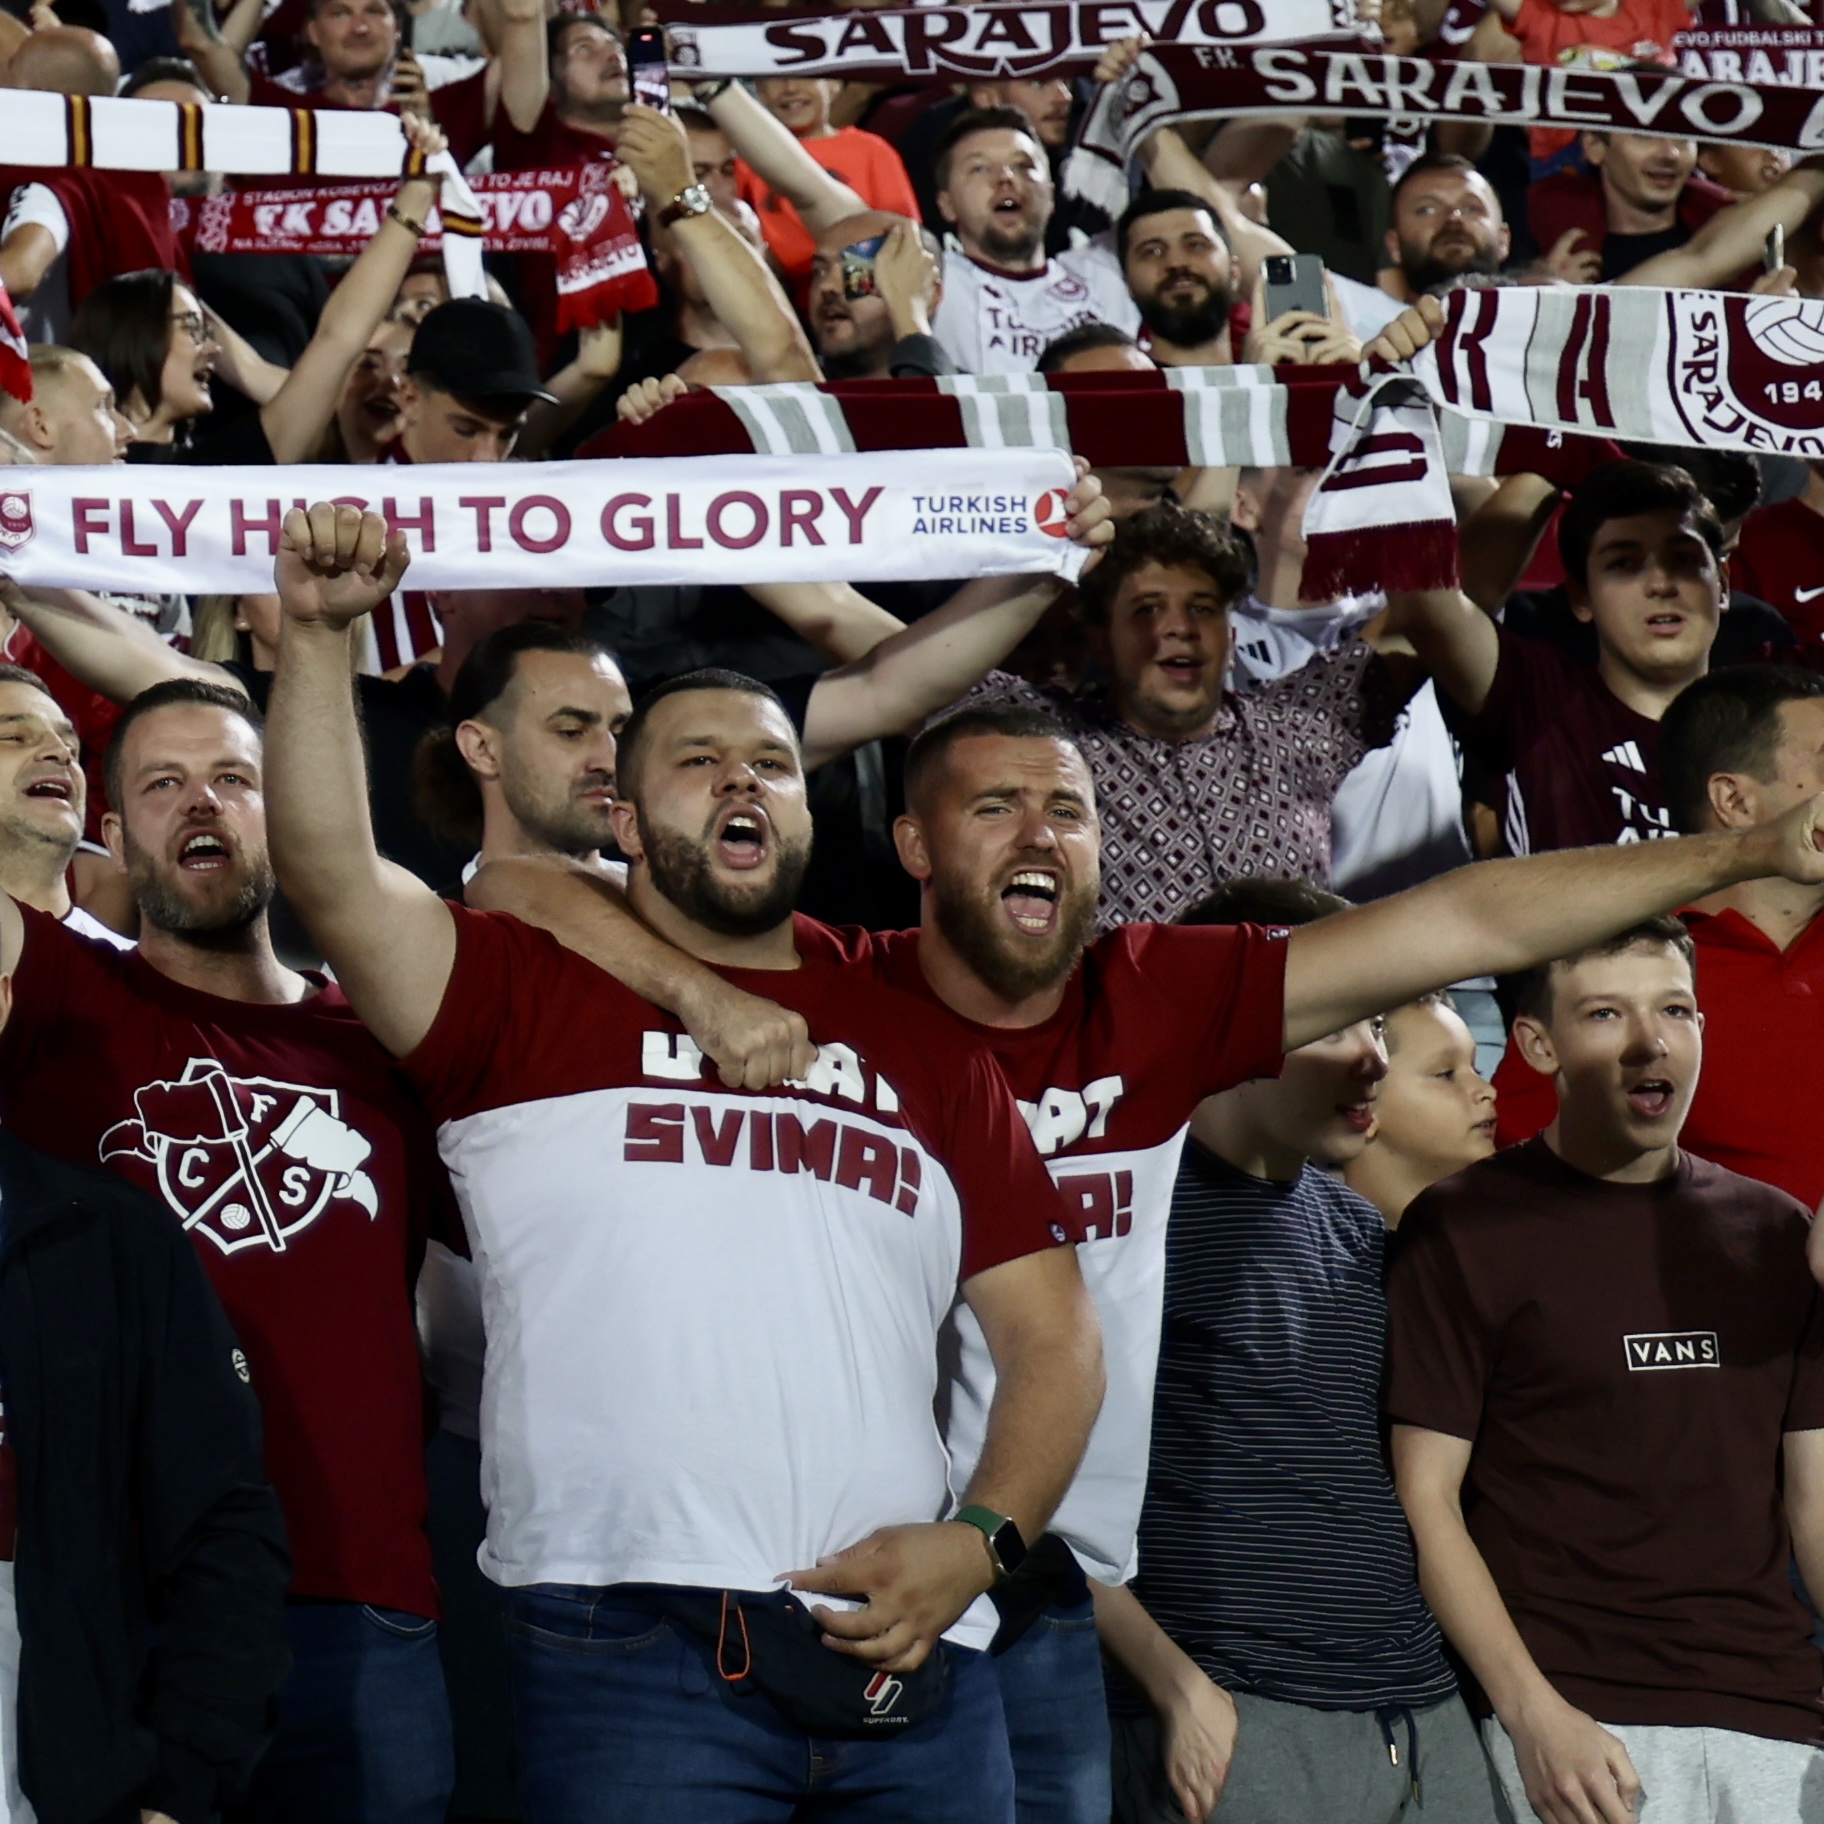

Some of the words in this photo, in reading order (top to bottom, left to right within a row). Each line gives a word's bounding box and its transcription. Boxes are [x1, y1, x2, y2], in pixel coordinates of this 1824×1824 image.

[1261, 45, 1765, 139] SARAJEVO
[71, 497, 204, 557] FLY
[230, 495, 436, 556] HH
[458, 494, 573, 555] TO
[598, 485, 886, 553] GLORY
[910, 496, 1028, 516] TURKISH
[910, 515, 1031, 537] AIRLINES
[177, 1145, 209, 1188] C
[622, 1101, 922, 1219] SVIMA!
[279, 1165, 310, 1210] S
[1631, 1338, 1713, 1365] VANS
